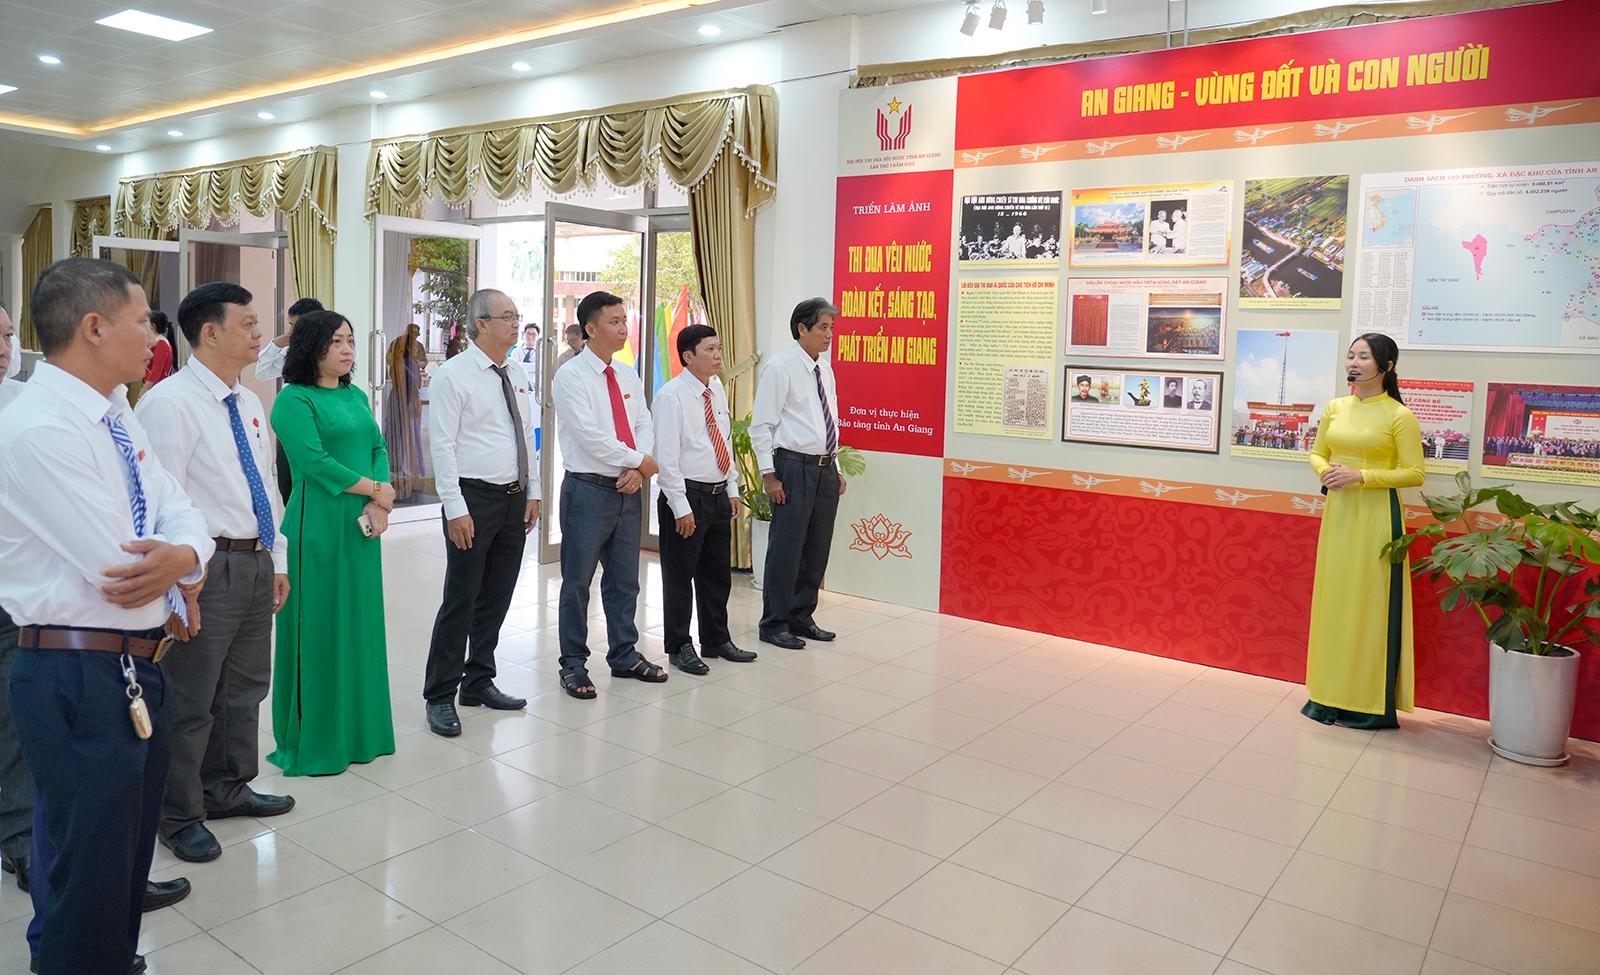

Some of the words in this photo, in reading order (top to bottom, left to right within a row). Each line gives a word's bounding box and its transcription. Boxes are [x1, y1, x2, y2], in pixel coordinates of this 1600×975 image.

[1081, 88, 1108, 117] AN
[1114, 81, 1175, 114] GIANG
[1195, 71, 1255, 106] VÙNG
[1261, 59, 1303, 100] ĐẤT
[1309, 58, 1341, 95] VÀ
[1347, 56, 1400, 92] CON
[1406, 43, 1489, 87] NGƯỜI
[853, 201, 881, 214] TRIỂN
[884, 202, 905, 213] LÃM
[908, 201, 931, 212] ẢNH
[849, 246, 863, 273] THI
[865, 246, 883, 273] ĐUA
[886, 240, 903, 272] YÊU
[905, 240, 932, 272] NƯỚC
[842, 286, 866, 318] ĐOÀN
[868, 283, 886, 319] KẾT,
[888, 286, 914, 319] SÁNG
[917, 291, 936, 325] TẠO,
[838, 330, 861, 362] PHÁT
[863, 325, 888, 363] TRIỂN
[890, 336, 904, 364] AN
[907, 337, 937, 365] GIANG
[838, 419, 851, 427] Bảo
[853, 420, 872, 431] tàng
[874, 421, 890, 430] tỉnh
[893, 423, 905, 432] An
[908, 424, 933, 436] Giang
[850, 406, 867, 415] Đơn
[869, 408, 877, 418] vị
[880, 408, 898, 419] thực
[901, 410, 919, 421] hiện
